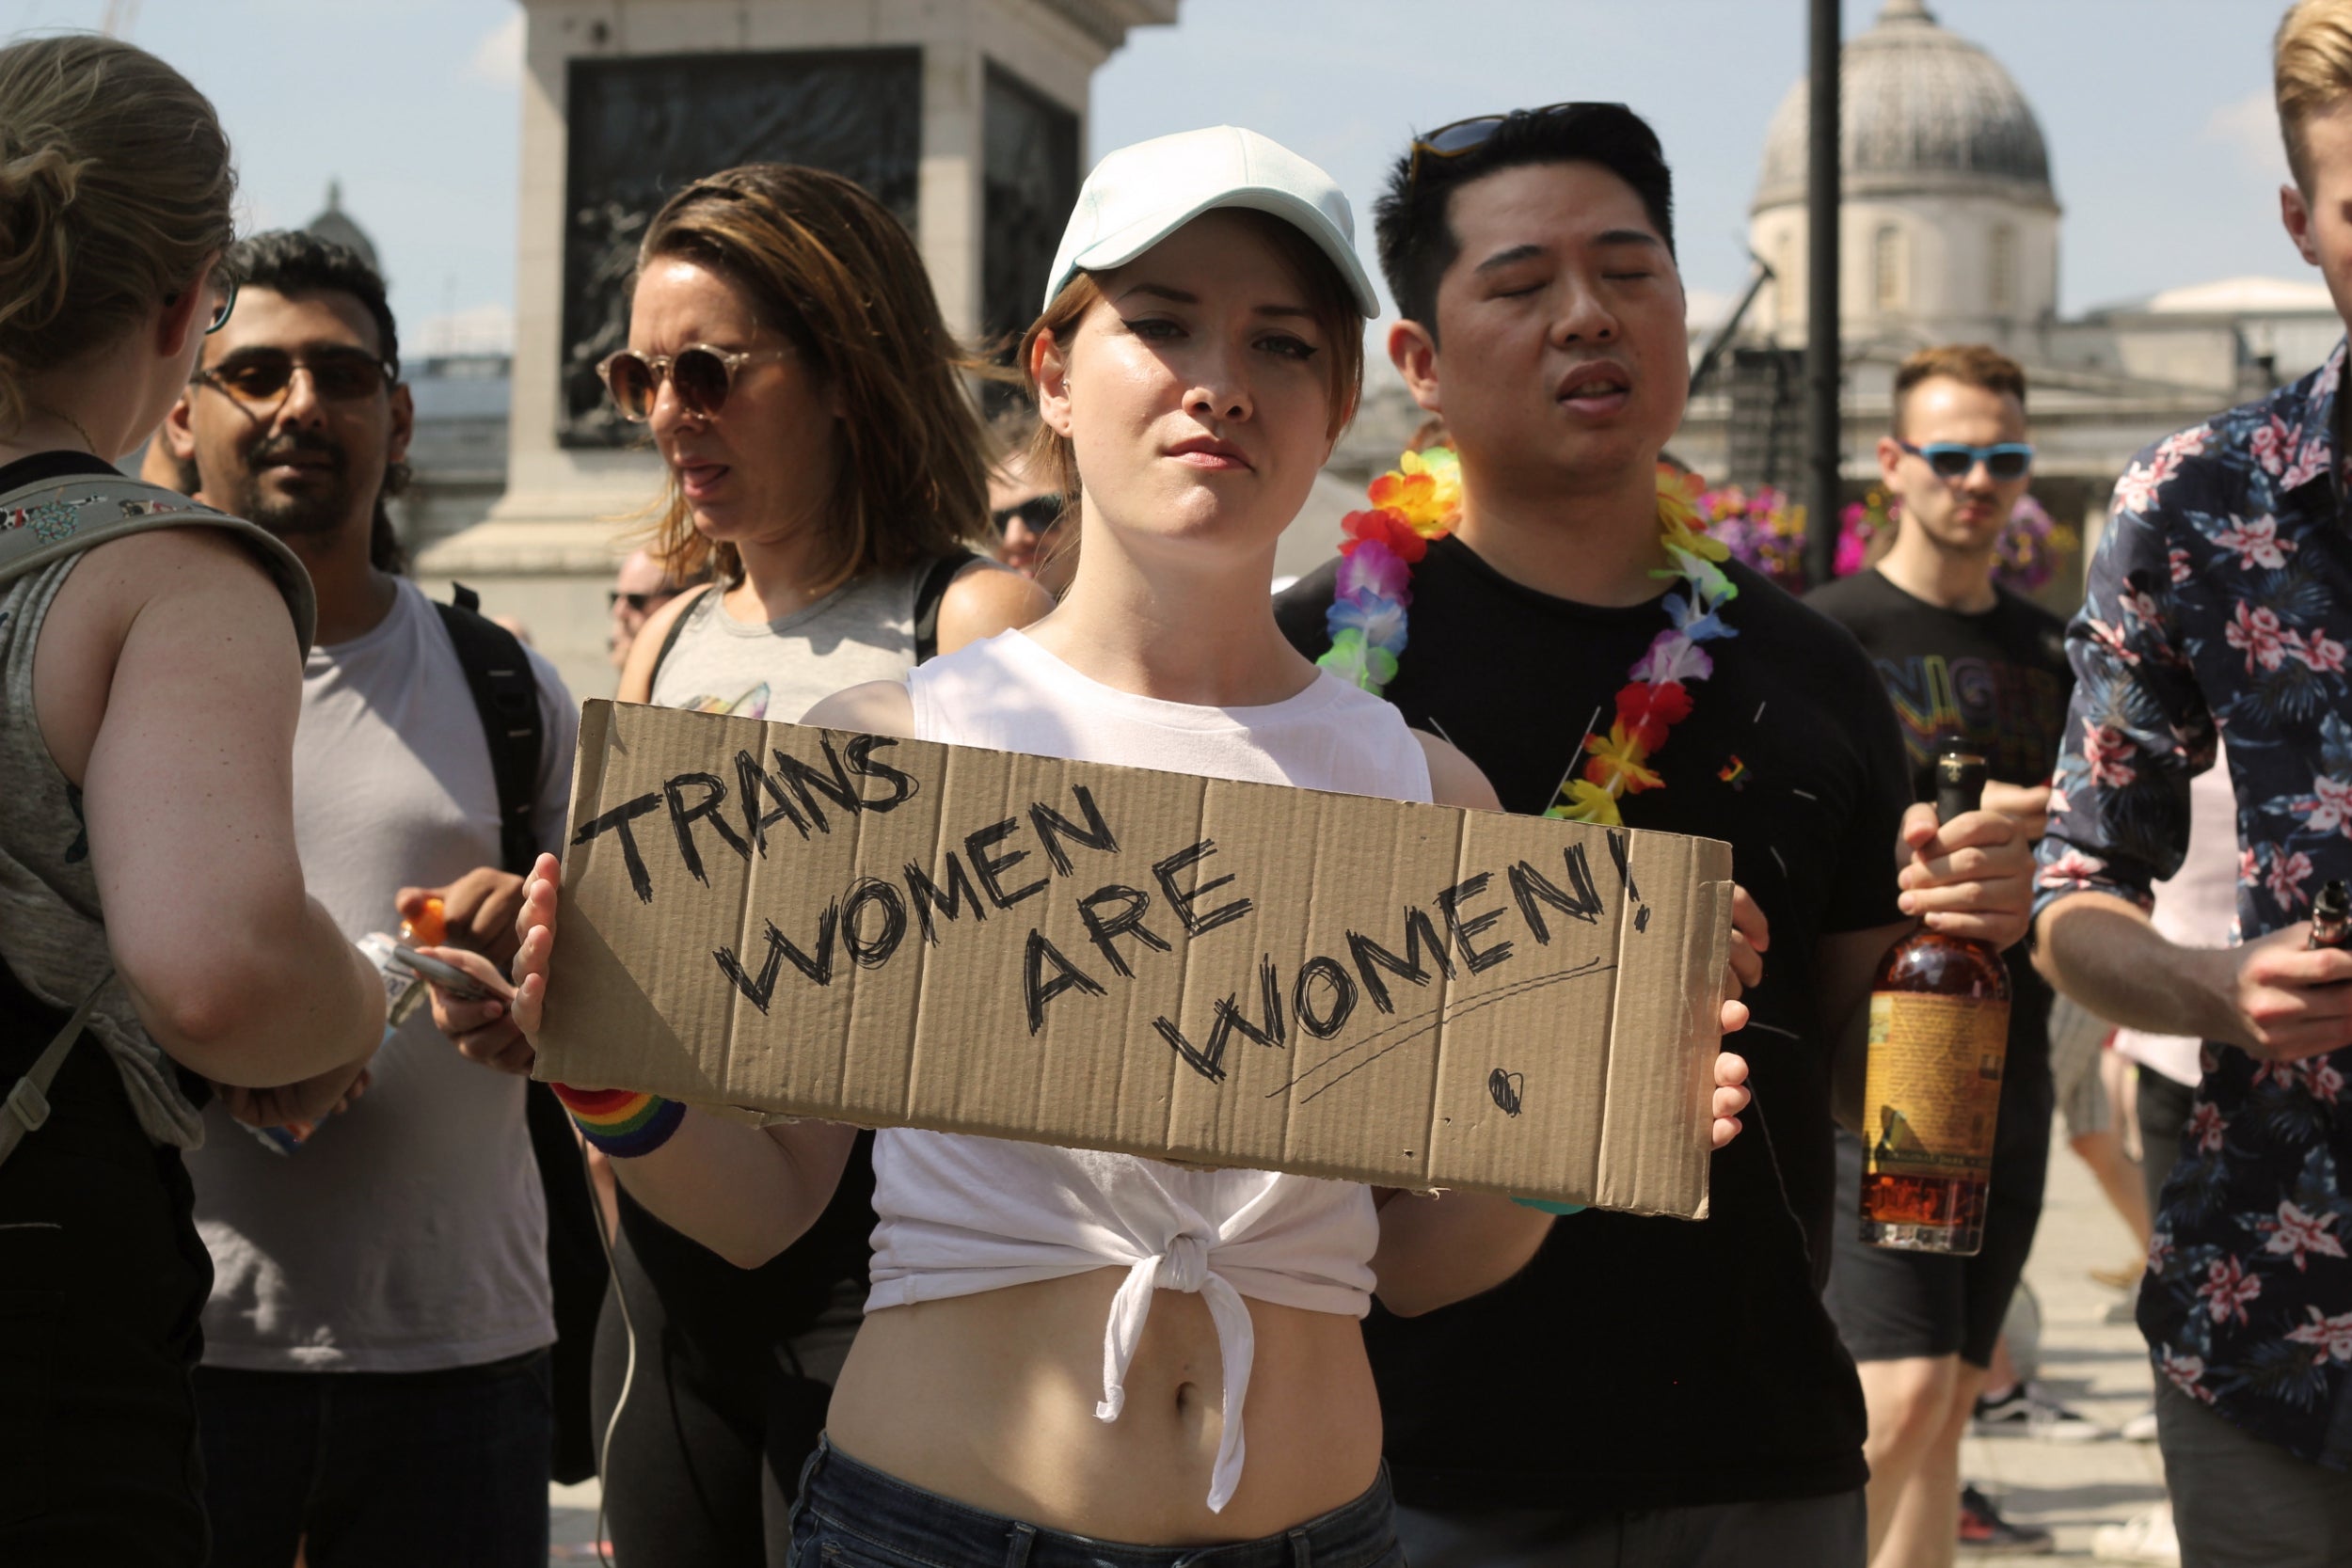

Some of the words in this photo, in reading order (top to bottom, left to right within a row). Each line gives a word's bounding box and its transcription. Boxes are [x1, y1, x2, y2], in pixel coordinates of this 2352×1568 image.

[570, 729, 919, 905] TRANS
[712, 784, 1121, 1022] WOMEN
[1023, 835, 1254, 1037] ARE
[1152, 829, 1650, 1085] WOMEN!
